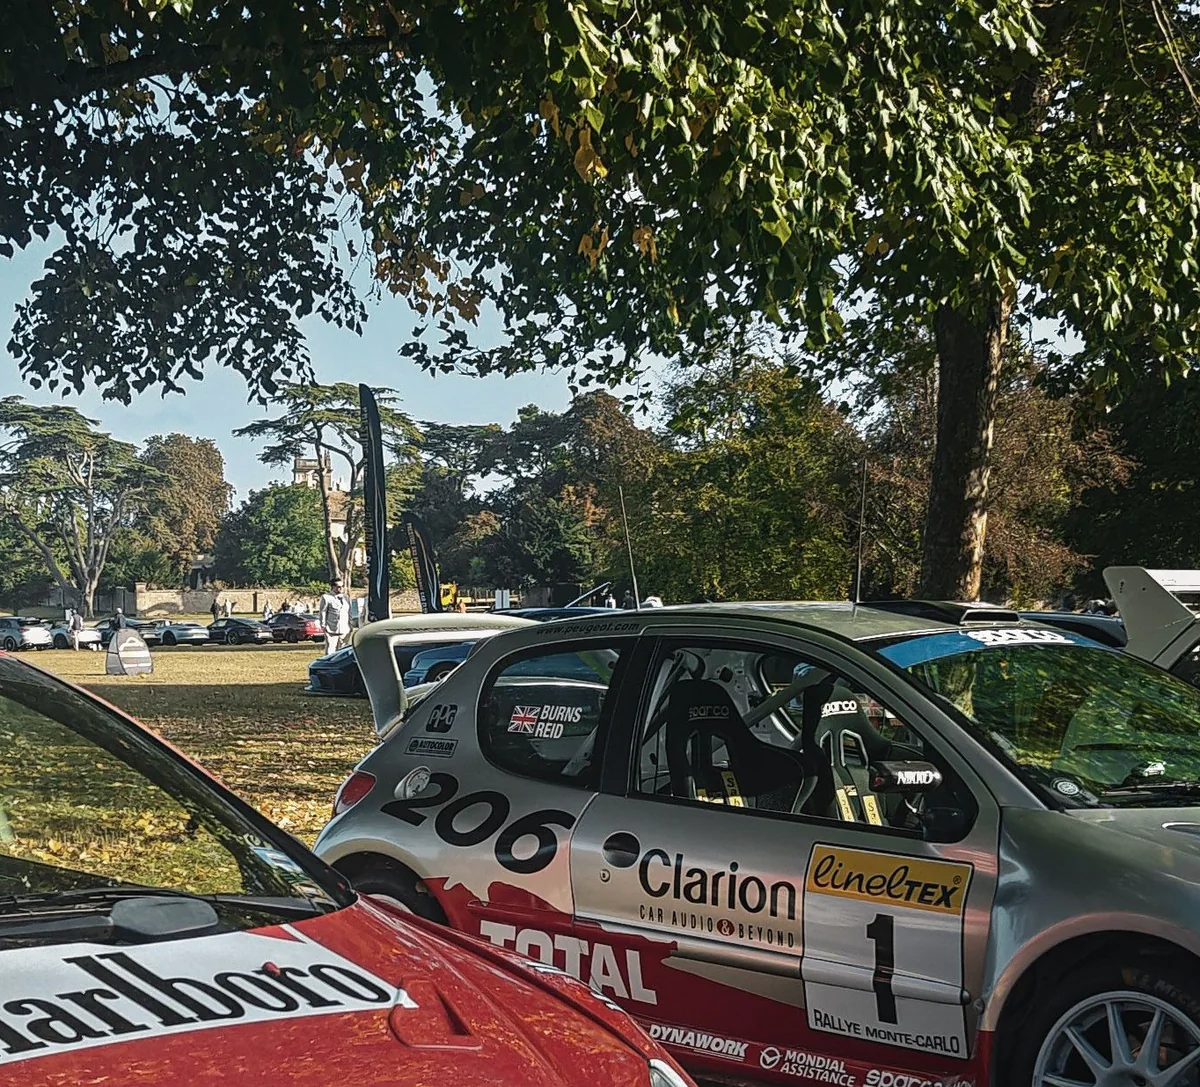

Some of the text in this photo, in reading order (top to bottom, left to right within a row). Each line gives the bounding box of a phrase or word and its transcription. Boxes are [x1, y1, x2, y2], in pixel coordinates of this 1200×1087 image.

[536, 622, 640, 635] www.peugeot.com
[540, 704, 583, 723] BURNS
[688, 704, 731, 718] sparco
[821, 700, 859, 716] sparco
[534, 721, 564, 739] REID
[379, 772, 577, 874] 206
[638, 848, 796, 921] Clarion
[639, 904, 795, 948] CAR AUDIO & BEYOND
[866, 913, 898, 1025] 1
[649, 1024, 750, 1057] DYNAWORK
[813, 1008, 960, 1054] RALLYE MONTE-CARLO
[779, 1062, 857, 1087] ASSISTANCE
[784, 1050, 847, 1074] MONDIAL
